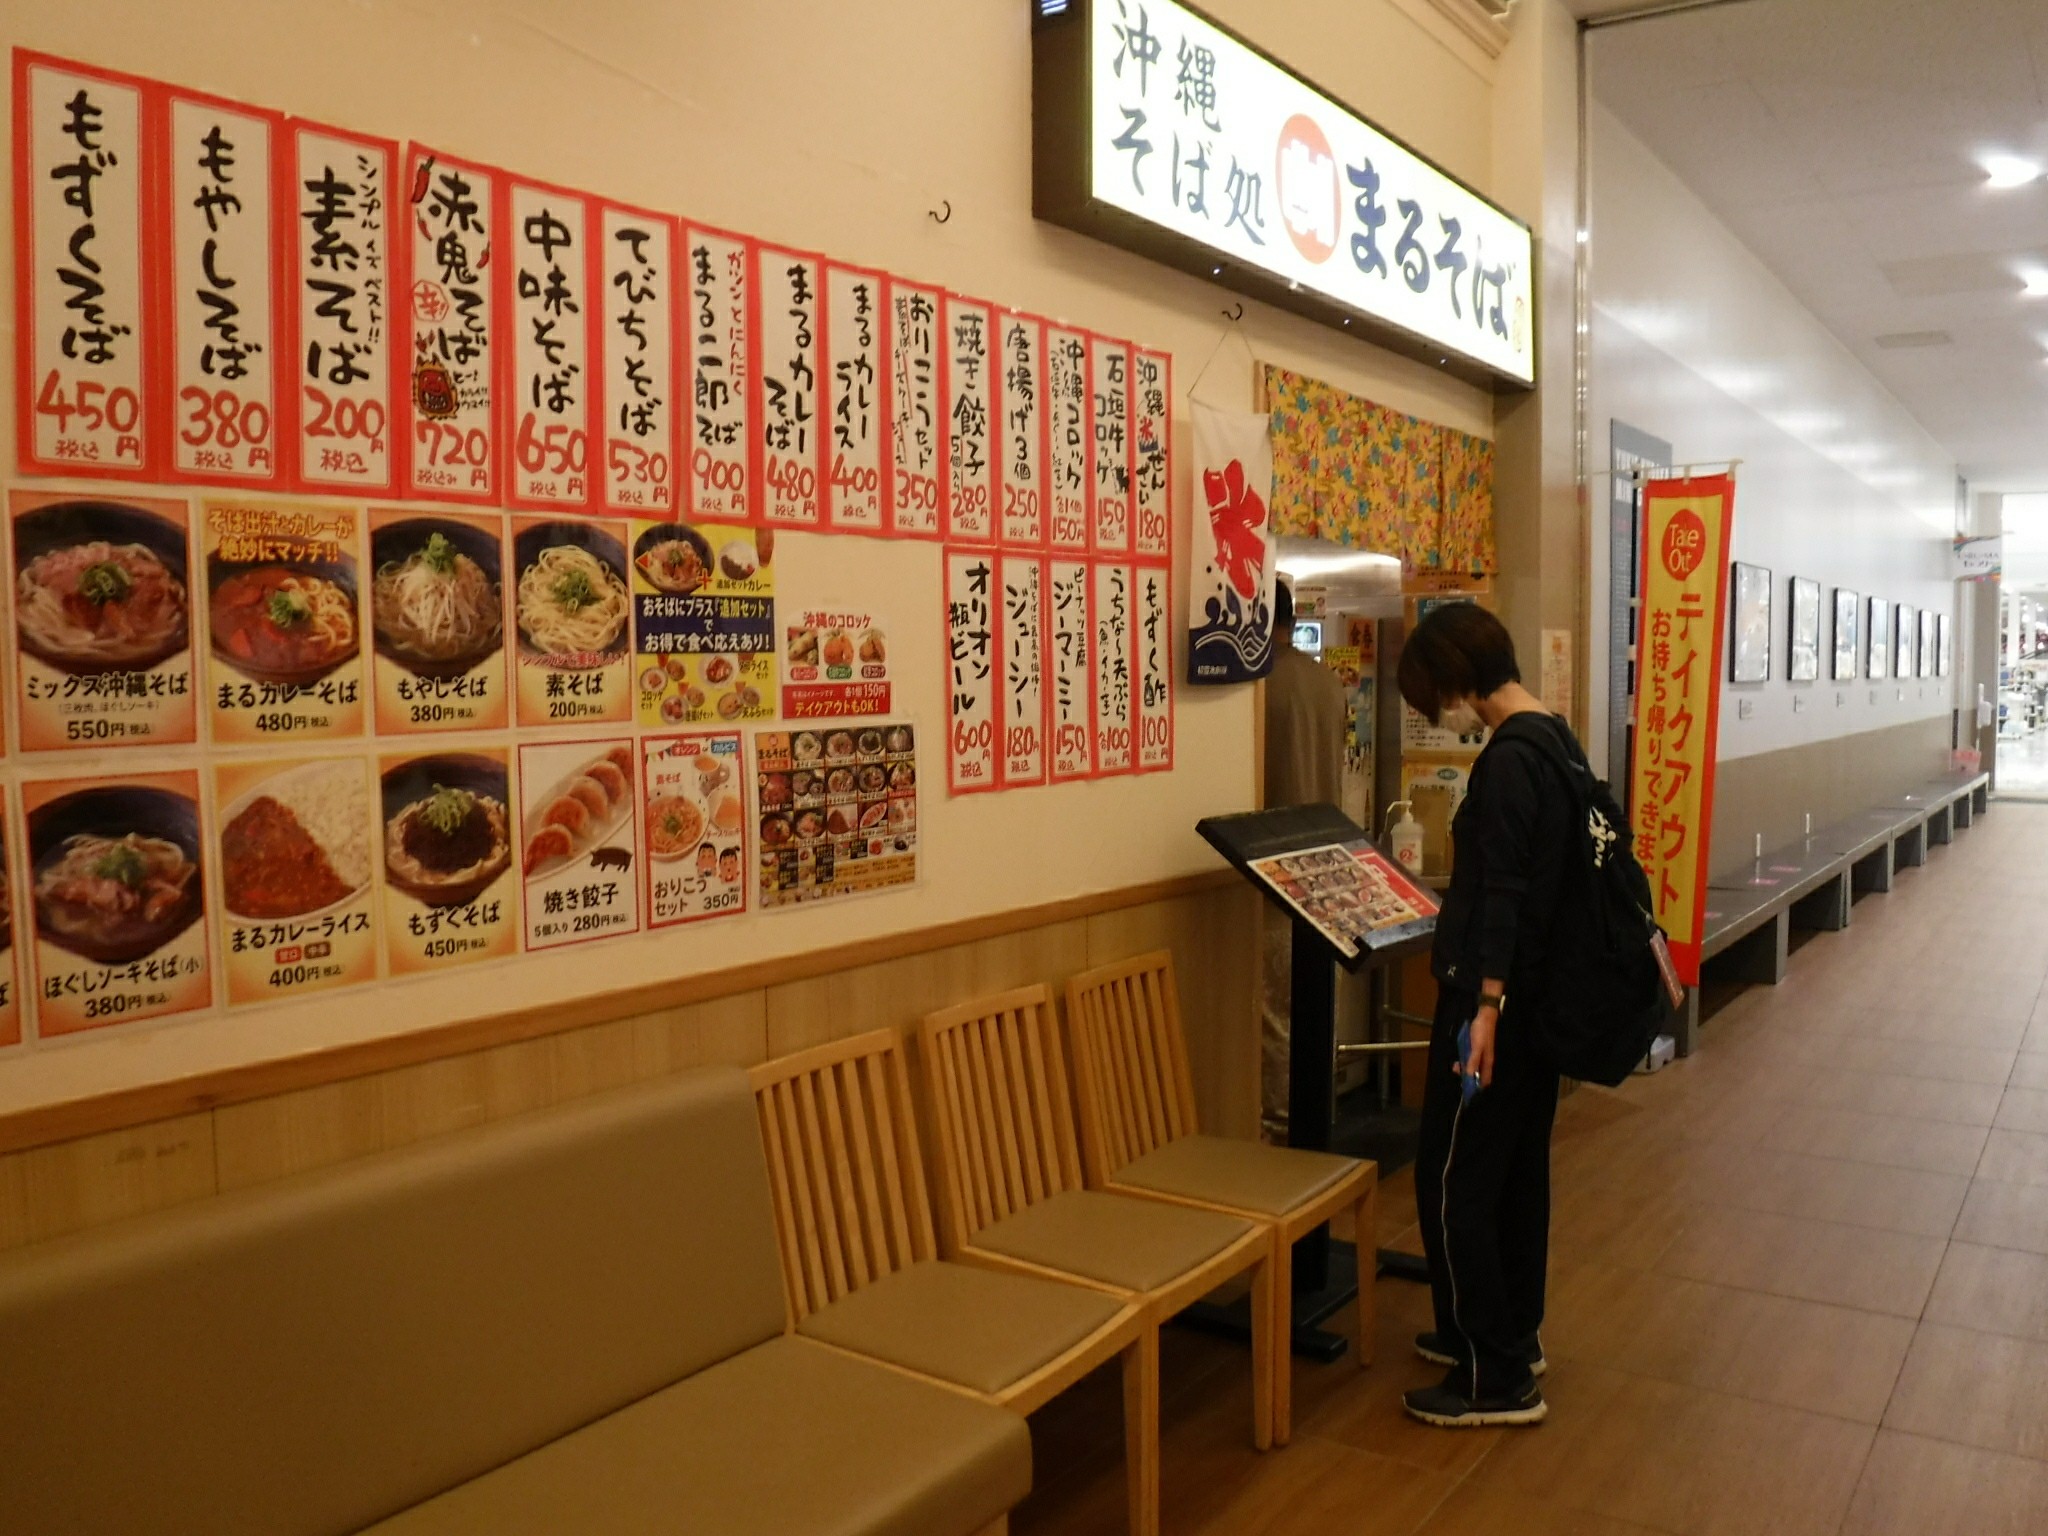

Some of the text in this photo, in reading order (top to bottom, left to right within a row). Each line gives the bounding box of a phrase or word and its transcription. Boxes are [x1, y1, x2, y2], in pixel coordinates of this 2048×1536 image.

[1112, 4, 1221, 133] 沖縄
[51, 90, 131, 364] もずくそば
[1112, 102, 1266, 246] そば処
[194, 126, 263, 380] もやしそば
[301, 165, 371, 385] 素そば
[518, 208, 580, 414] 中味そば
[1346, 156, 1515, 341] まるそば
[612, 227, 663, 437] てびちそば
[909, 292, 935, 470] おりこうセット
[952, 312, 986, 477] 焼き餃子
[546, 672, 605, 697] 素そば
[645, 632, 769, 652] お得で食べ応えあり!
[703, 619, 714, 632] で
[804, 611, 872, 628] 沖縄のコロッケ
[1006, 584, 1030, 718] ジューシー
[1054, 581, 1074, 720] ジーマーミー
[1143, 577, 1166, 707] もずく酢
[26, 672, 189, 700] ミックス沖縄そば
[217, 680, 358, 709] まるカレーそば
[397, 675, 488, 701] もやしそば
[795, 699, 879, 716] テイクアウトもOK!
[1660, 594, 1704, 916] テイクアウト
[231, 912, 371, 953] まるカレーライス
[408, 900, 501, 936] もずくそば
[543, 882, 620, 915] 焼き餃子
